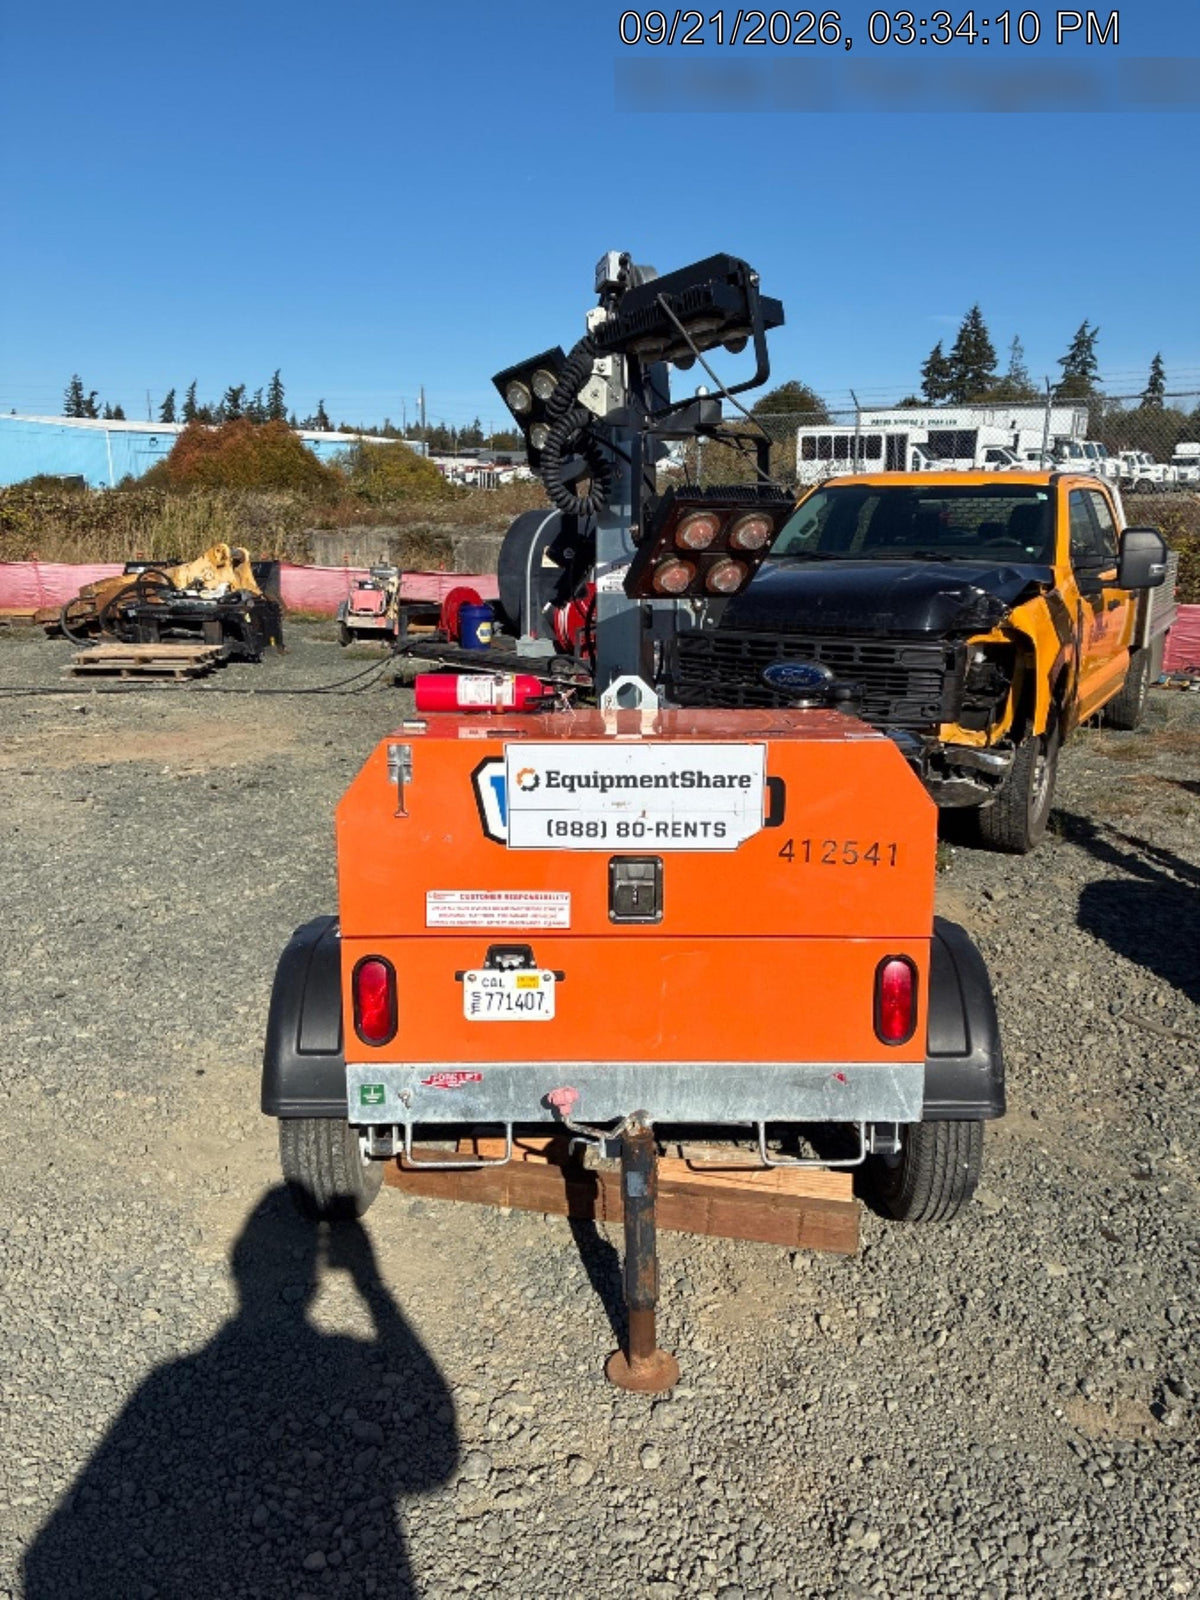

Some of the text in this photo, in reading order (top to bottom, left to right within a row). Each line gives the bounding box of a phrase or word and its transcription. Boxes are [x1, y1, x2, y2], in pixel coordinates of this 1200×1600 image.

[545, 770, 751, 792] EquipmentShare
[547, 820, 726, 839] (888) 80-RENTS
[778, 839, 898, 867] 412541
[481, 977, 505, 988] CAL
[485, 991, 545, 1011] 771407
